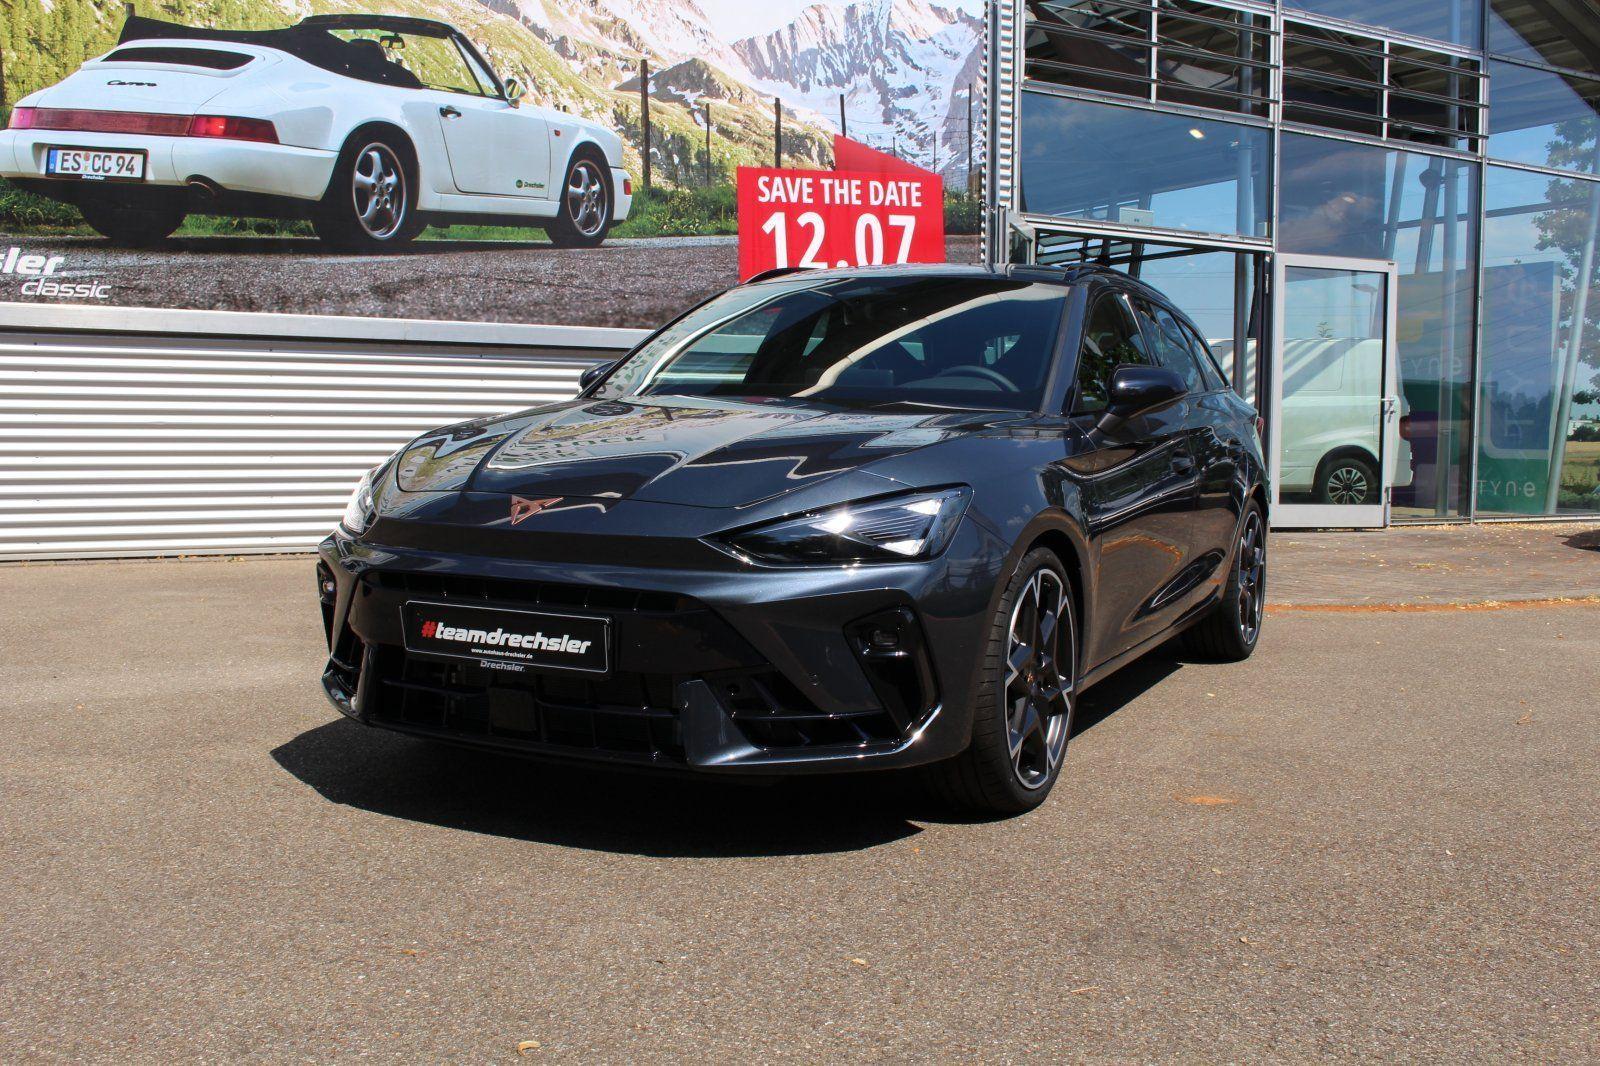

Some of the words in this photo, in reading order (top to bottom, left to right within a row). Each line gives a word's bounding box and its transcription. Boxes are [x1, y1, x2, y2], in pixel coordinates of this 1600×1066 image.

[60, 152, 82, 172] ES
[91, 153, 112, 174] CC
[116, 155, 136, 175] 94
[757, 176, 814, 204] SAVE
[820, 178, 862, 205] THE
[869, 180, 922, 207] DATE
[761, 211, 916, 269] 12.07
[21, 277, 112, 299] classic
[421, 621, 592, 654] #teamdrechsler
